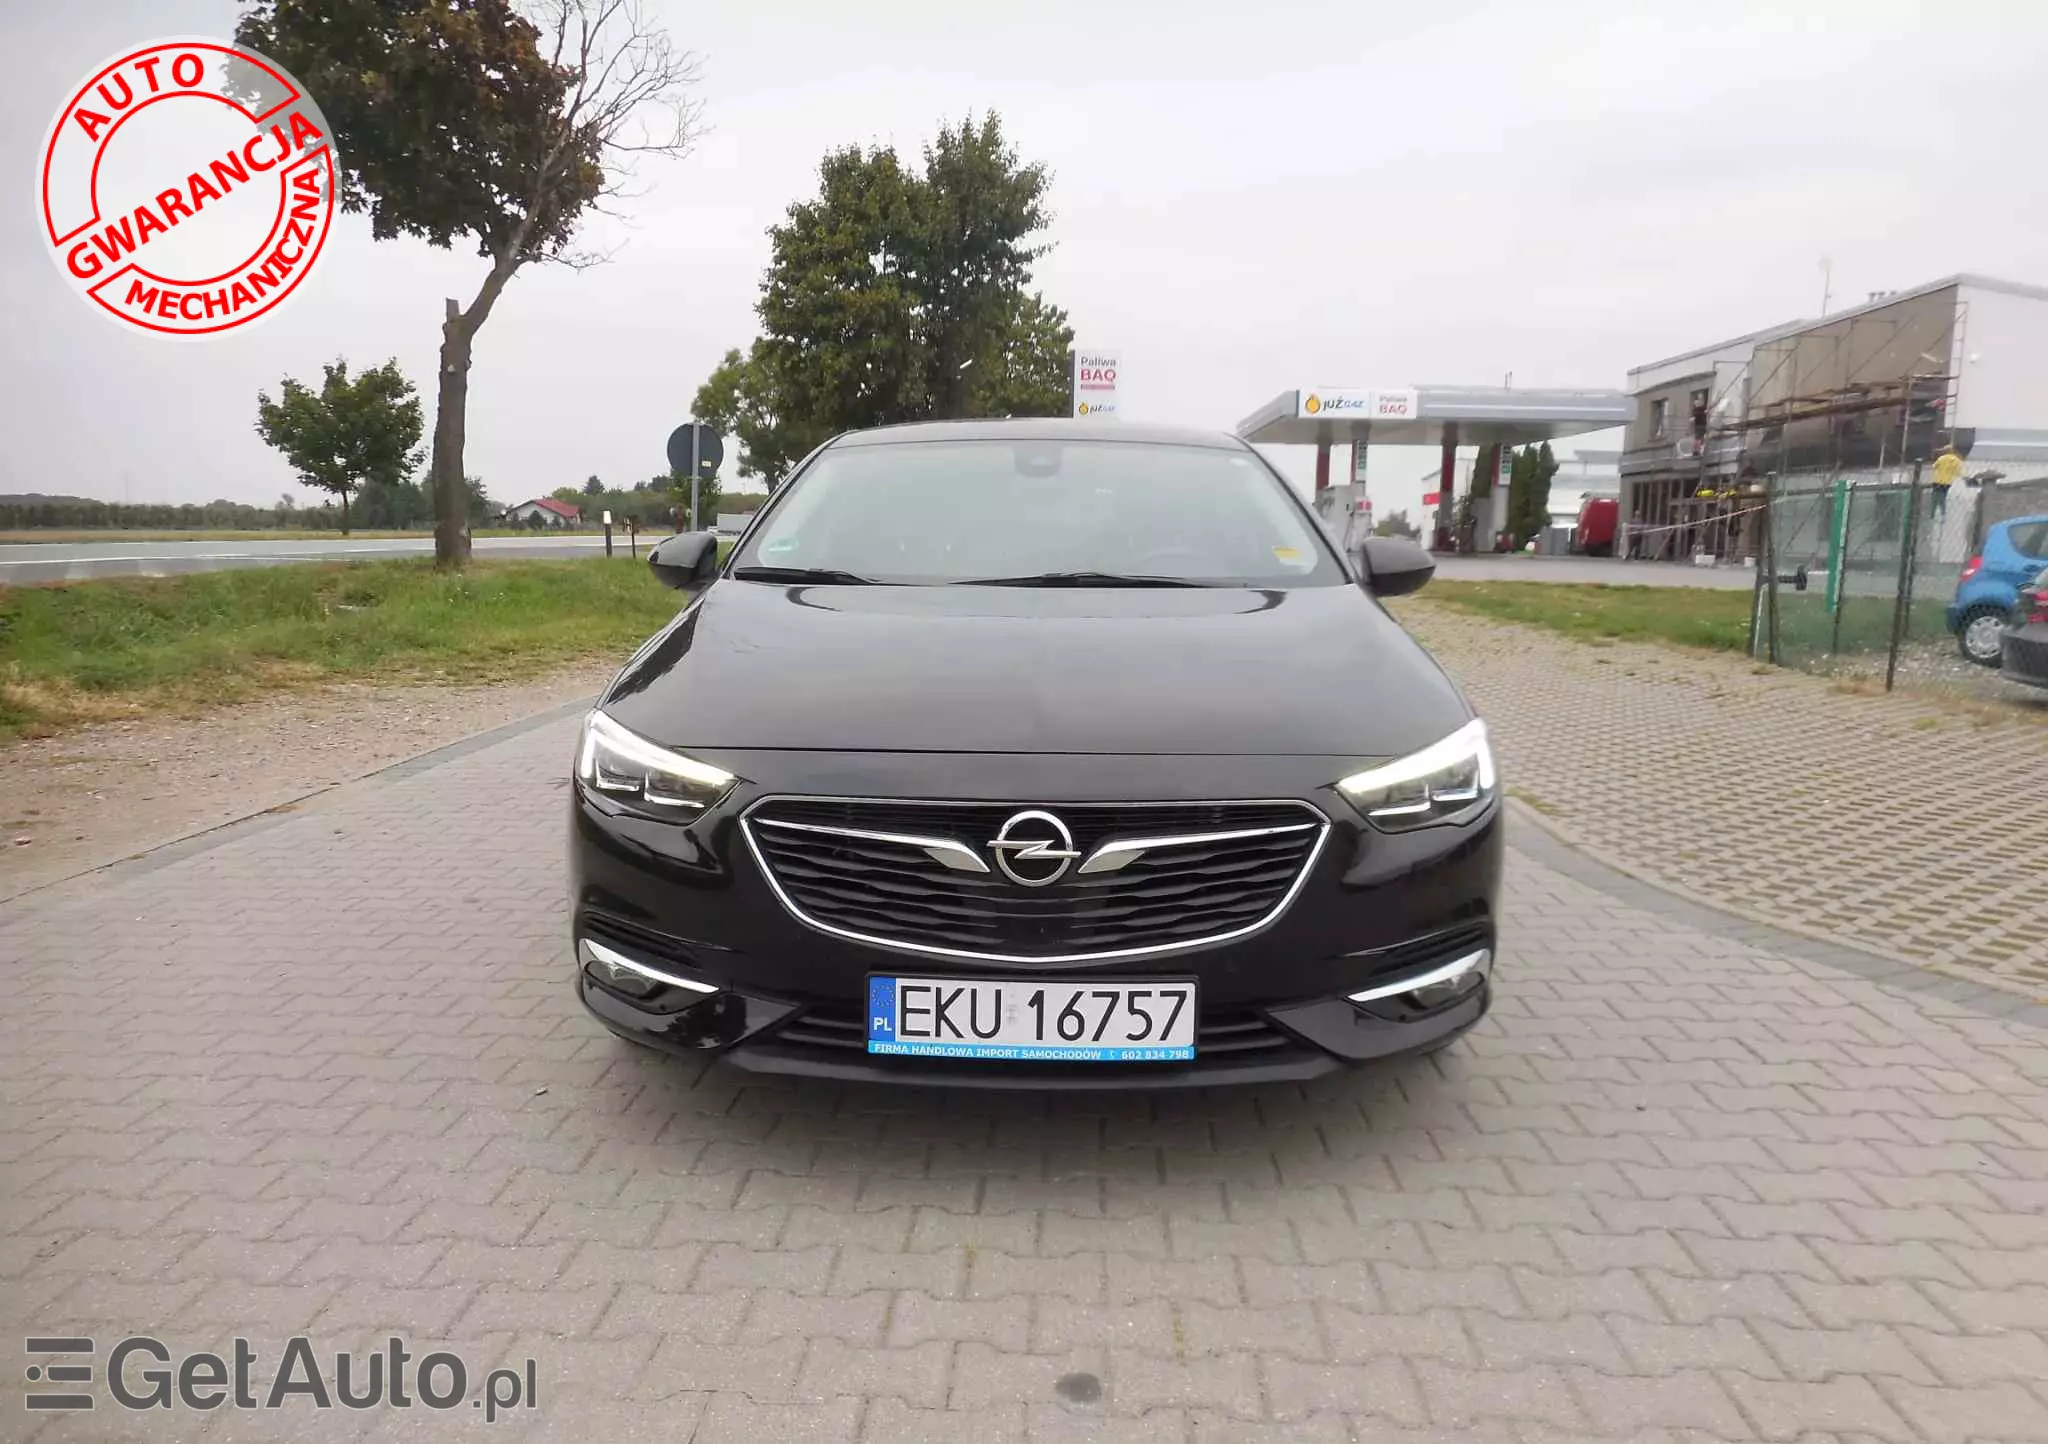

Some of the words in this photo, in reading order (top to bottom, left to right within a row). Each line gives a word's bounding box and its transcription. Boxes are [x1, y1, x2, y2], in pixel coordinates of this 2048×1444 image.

[1080, 368, 1117, 382] BAQ
[900, 985, 1002, 1039] EKU
[1027, 989, 1188, 1042] 16757
[873, 1017, 893, 1032] PL
[875, 1043, 908, 1055] FIRMA
[912, 1045, 973, 1057] HANDLOWA
[976, 1048, 1018, 1058] IMPORT
[1022, 1048, 1101, 1060] SAMOCHODÓW
[1121, 1050, 1144, 1061] 602
